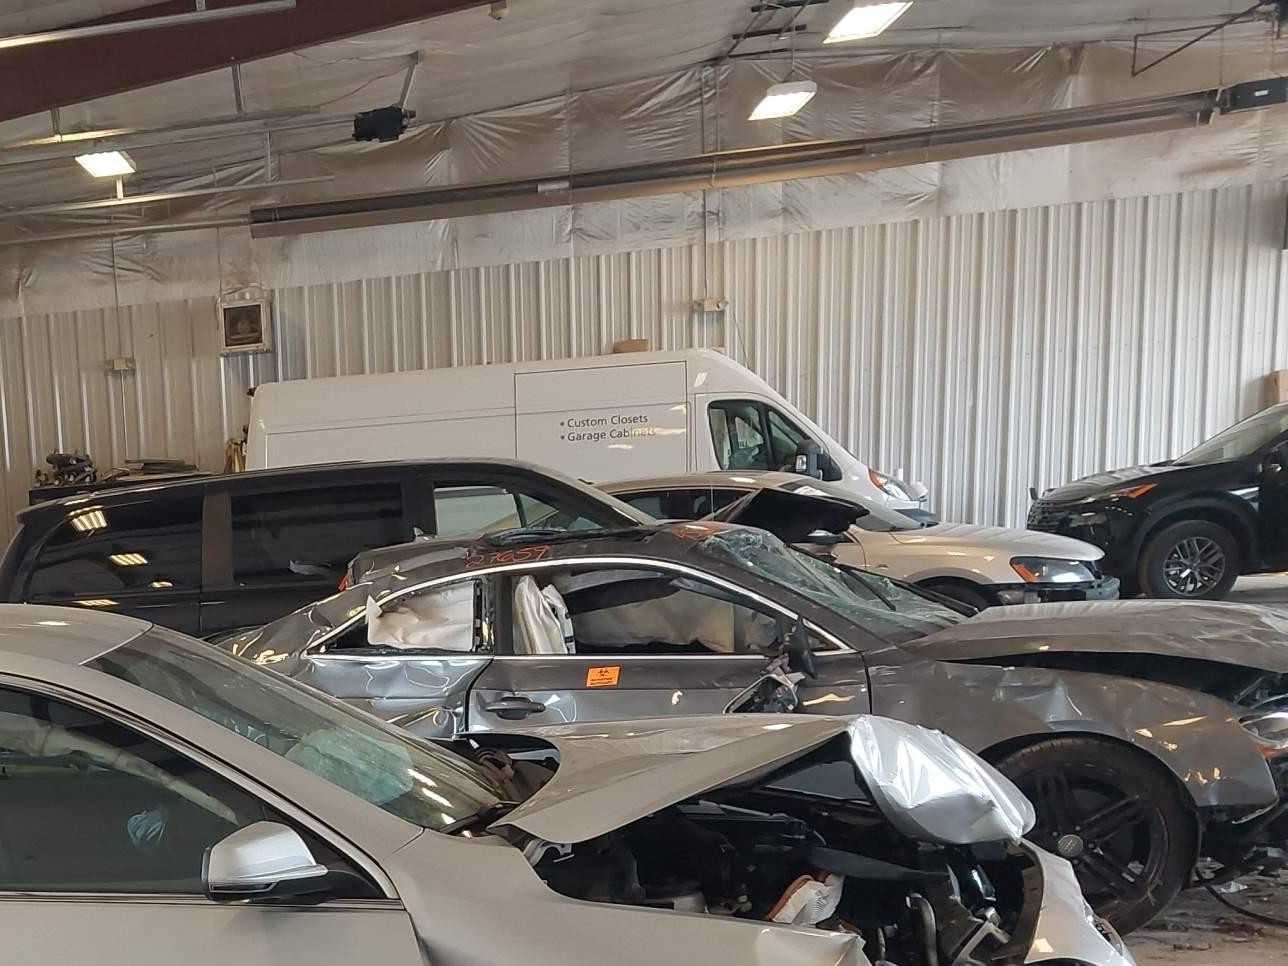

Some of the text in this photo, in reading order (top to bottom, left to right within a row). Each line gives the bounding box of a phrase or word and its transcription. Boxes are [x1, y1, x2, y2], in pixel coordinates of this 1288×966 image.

[567, 415, 648, 428] Custom Closets
[567, 427, 656, 442] Garage Cabinets
